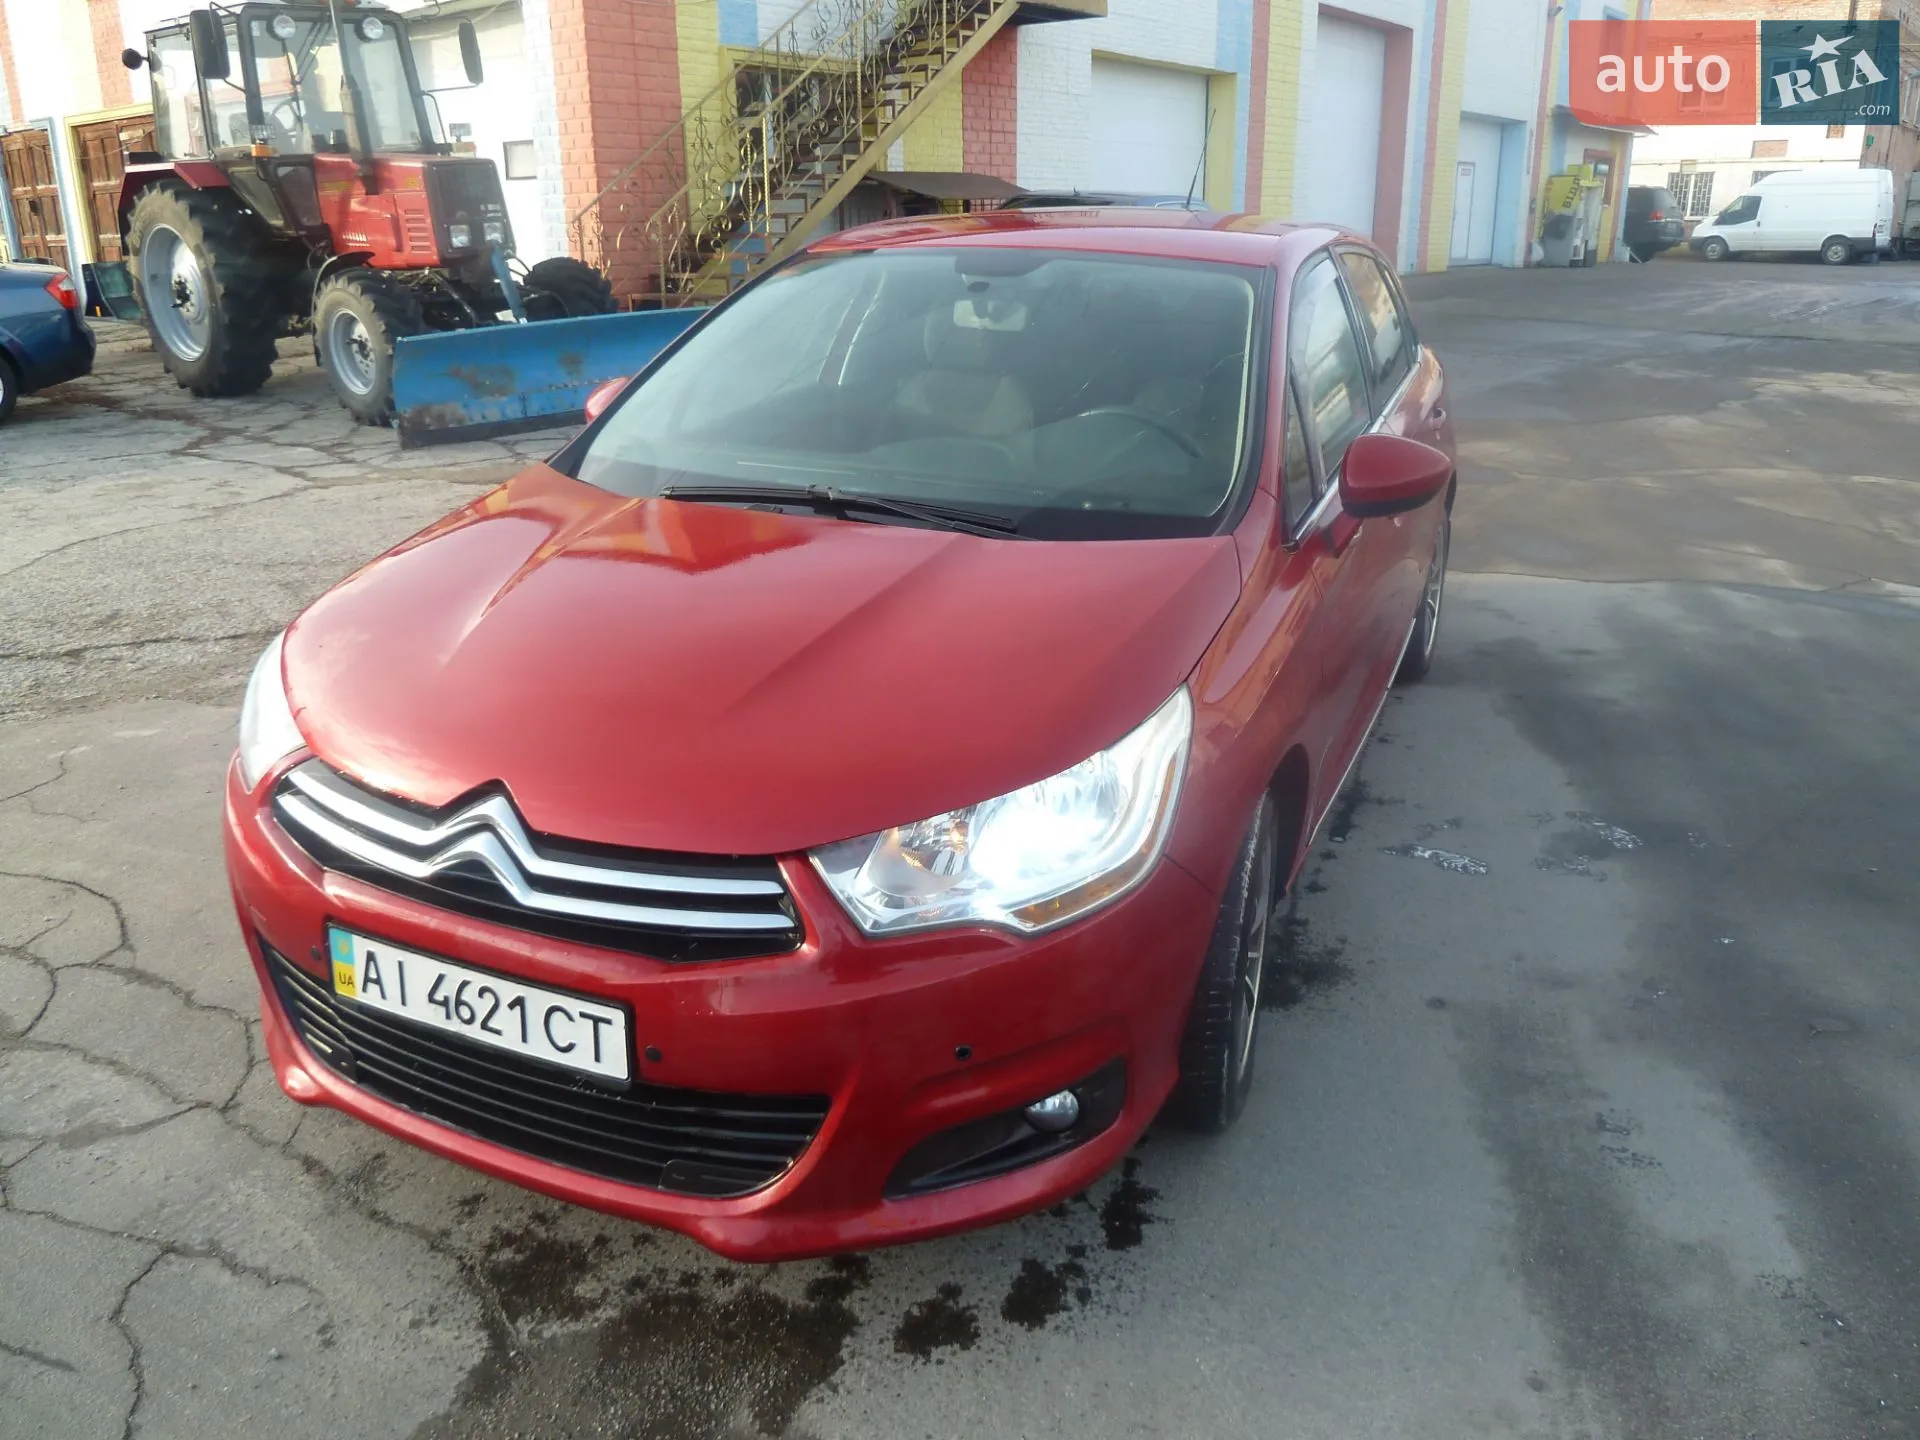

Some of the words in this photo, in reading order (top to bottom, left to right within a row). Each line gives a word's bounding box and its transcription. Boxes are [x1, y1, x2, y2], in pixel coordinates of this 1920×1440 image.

[338, 971, 355, 988] UA
[361, 950, 408, 1006] AI
[427, 973, 528, 1044] 4621
[543, 1004, 612, 1063] CT
